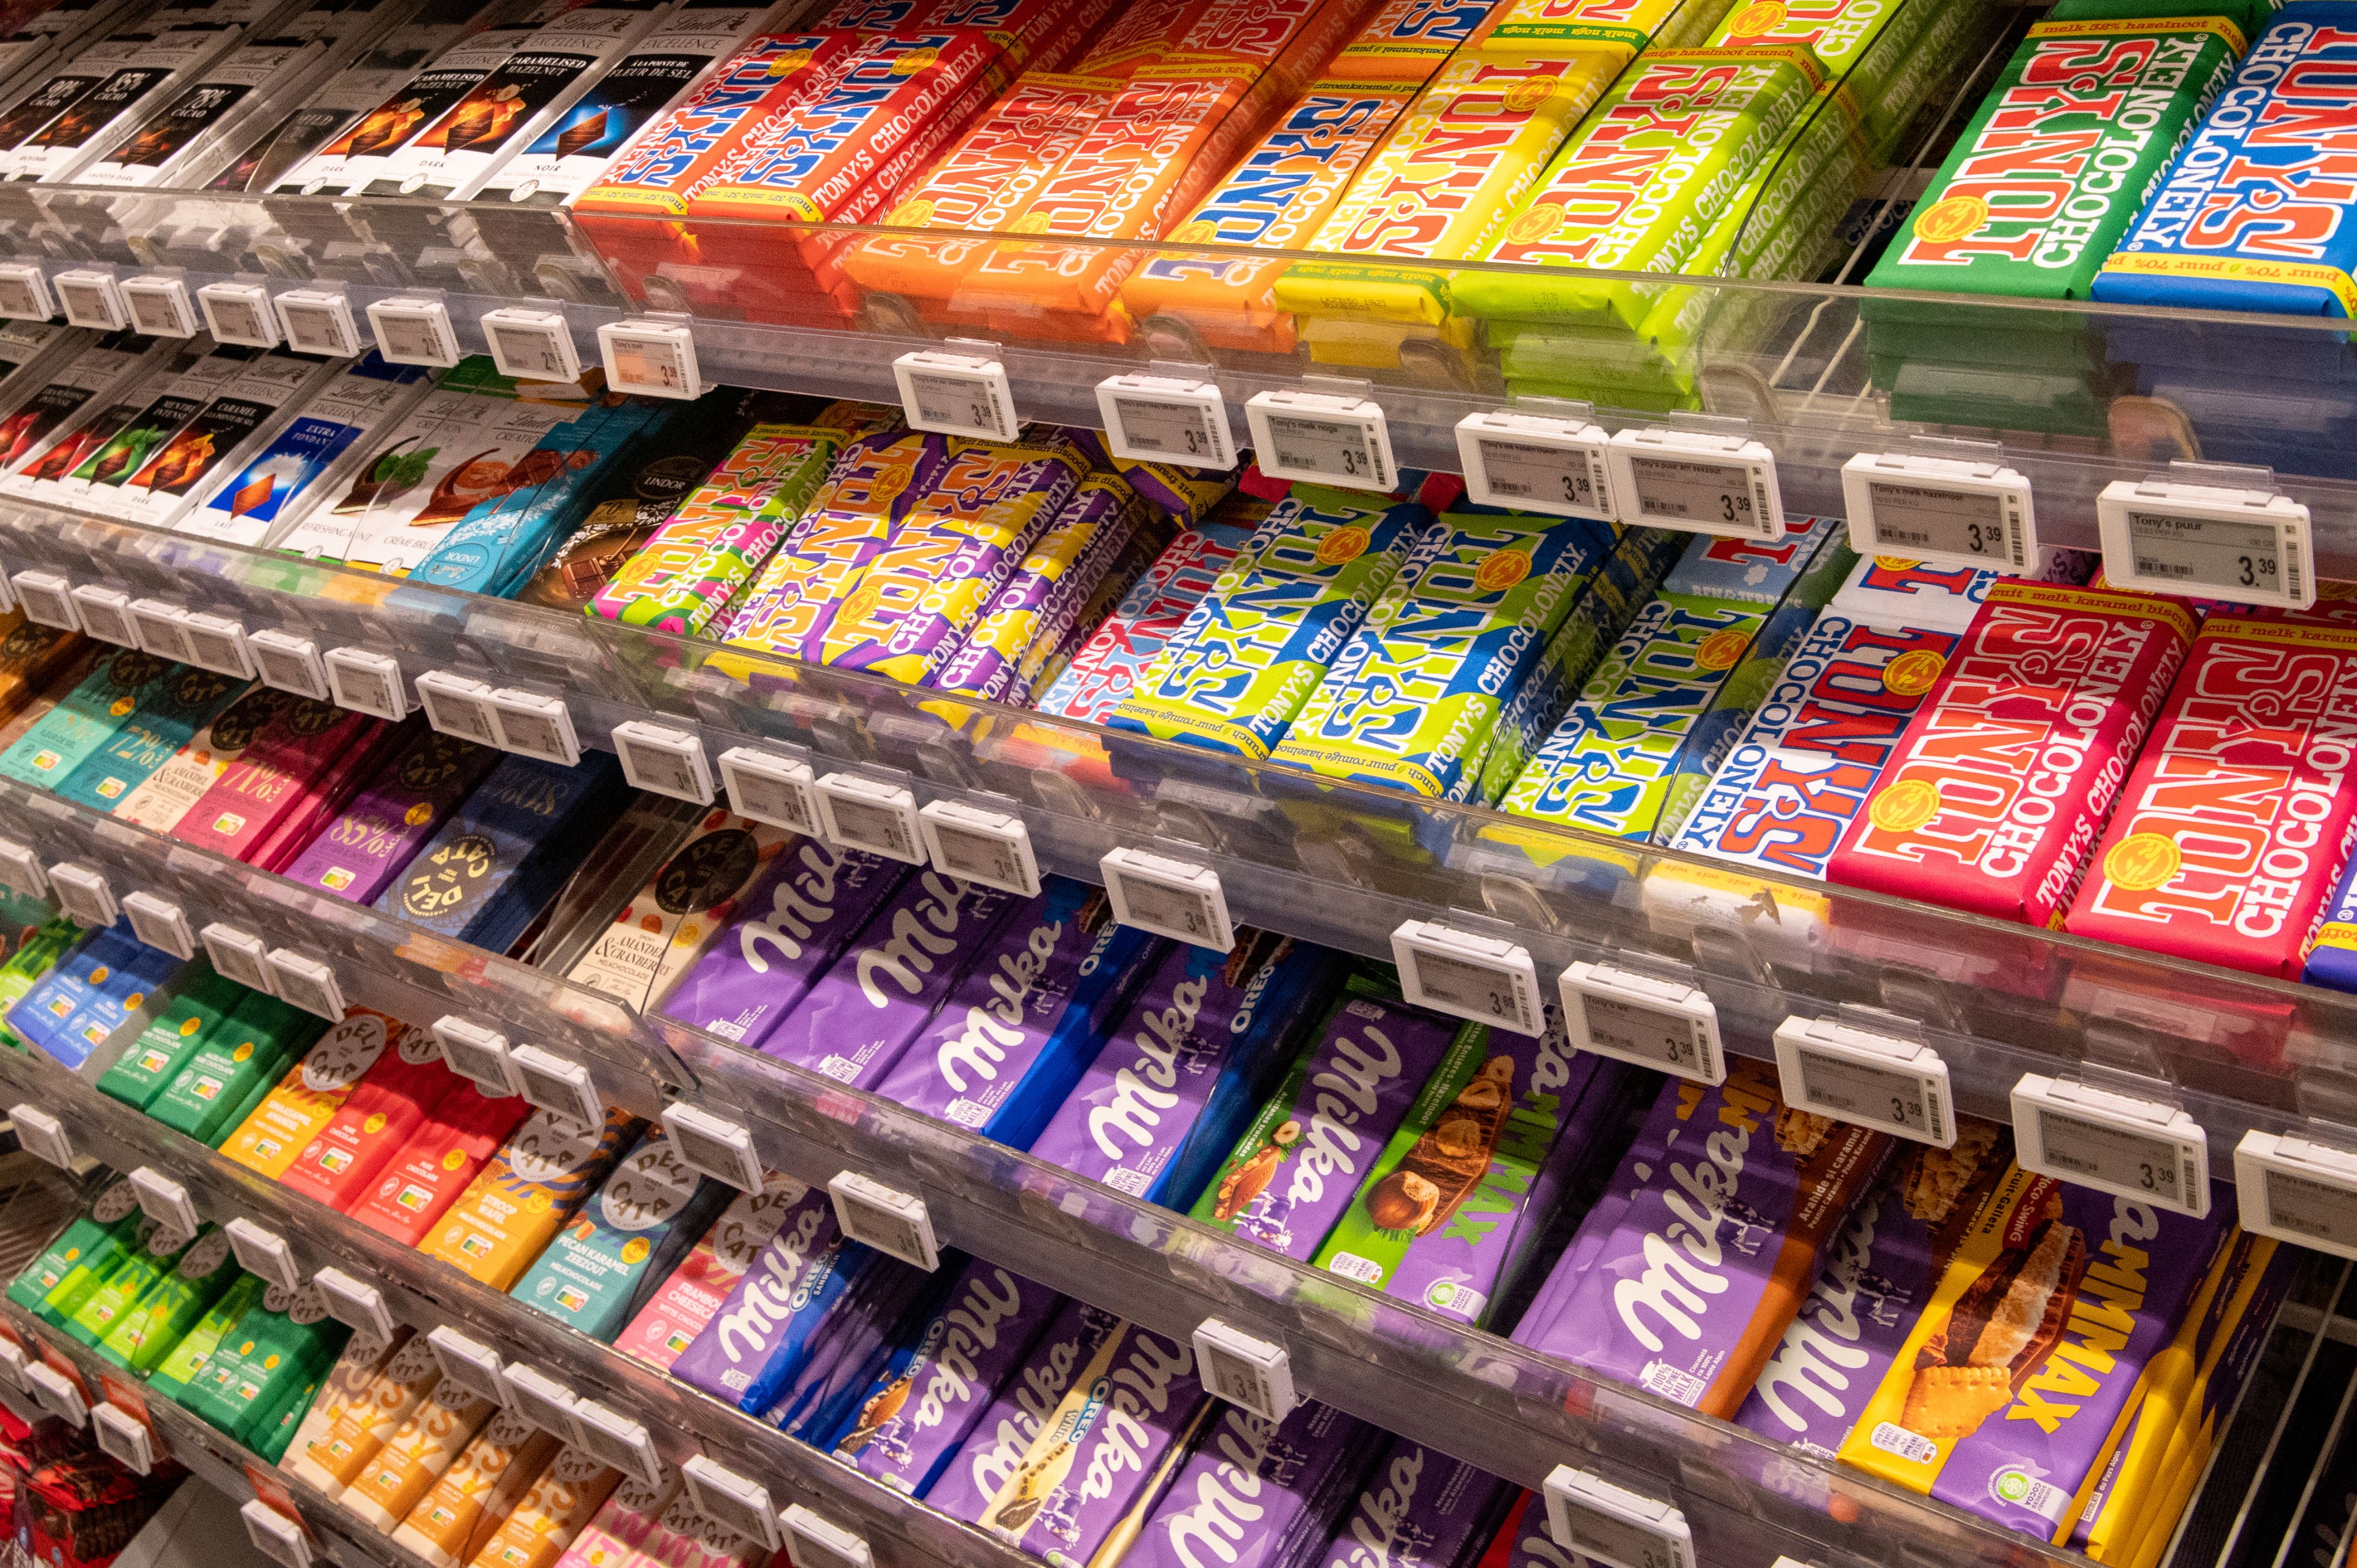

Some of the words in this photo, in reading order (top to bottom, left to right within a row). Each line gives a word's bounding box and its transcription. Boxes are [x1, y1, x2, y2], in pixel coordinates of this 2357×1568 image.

[527, 37, 610, 49] EXCELLENCE
[641, 37, 724, 50] EXCELLENCE
[1502, 26, 1531, 35] noga
[1536, 28, 1565, 36] melk
[1571, 28, 1602, 37] noga
[1606, 28, 1638, 39] melk
[2043, 25, 2084, 33] melk
[2088, 23, 2120, 32] 32%
[2125, 20, 2209, 29] hazelnoot
[505, 66, 567, 77] HAZELNUT
[507, 57, 587, 69] CARAMELISED
[1681, 49, 1744, 57] hazelnoot
[1745, 49, 1795, 58] crunch
[611, 68, 647, 78] FLEUR
[649, 68, 667, 78] DE
[669, 70, 693, 79] SEL
[1313, 83, 1392, 92] citroenkaramel
[604, 36, 762, 187] CHOCOLONELY
[624, 35, 829, 186] TONY'S
[741, 35, 955, 188] TONY'S
[811, 149, 874, 211] TONY'S
[870, 44, 985, 153] CHOCOLONELY
[1898, 38, 2159, 265] TONY'S
[2032, 36, 2199, 268] CHOCOLONELY
[2130, 22, 2313, 249] CHOCOLONELY
[419, 161, 447, 169] DARK
[685, 147, 740, 203] TONY'S
[1310, 59, 1479, 254] CHOCOLONELY
[1343, 59, 1576, 257] TONY'S
[1486, 64, 1741, 265] TONY'S
[1588, 61, 1776, 269] CHOCOLONELY
[980, 81, 1201, 273] TONY'S
[1138, 97, 1380, 280] TONY'S
[1631, 216, 1698, 299] TONY'S
[1696, 77, 1809, 221] CHOCOLONELY
[791, 196, 814, 215] melk
[2134, 258, 2169, 269] 70%
[2175, 261, 2226, 272] puur
[2245, 266, 2282, 277] 70%
[2287, 269, 2341, 283] puur
[307, 425, 335, 436] EXTRA
[1271, 418, 1295, 431] Tony's
[644, 476, 686, 490] LINDOR
[1874, 484, 1900, 496] Tony's
[602, 441, 790, 602] TONY'S
[2134, 515, 2173, 532] Tony's
[2175, 520, 2203, 532] puur
[746, 446, 928, 651] TONY'S
[820, 457, 1021, 647] TONY'S
[888, 459, 1050, 654] CHOCOLONELY
[921, 604, 980, 674] TONY'S
[975, 473, 1081, 606] CHOCOLONELY
[939, 486, 1100, 689] CHOCOLONELY
[2238, 555, 2276, 587] 3.39
[1133, 497, 1302, 692] CHOCOLONELY
[1156, 507, 1386, 716] TONY'S
[1043, 532, 1203, 714] CHOCOLONELY
[1248, 662, 1314, 737] TONY'S
[1307, 523, 1419, 663] CHOCOLONELY
[1295, 522, 1453, 737] CHOCOLONELY
[2032, 592, 2072, 604] melk
[2074, 594, 2143, 612] karamel
[2147, 603, 2194, 639] biscuit
[2251, 625, 2294, 638] melk
[1319, 528, 1547, 753] TONY'S
[1426, 694, 1487, 775] TONY'S
[1478, 543, 1582, 694] CHOCOLONELY
[1159, 715, 1193, 728] romige
[1509, 600, 1672, 811] CHOCOLONELY
[1534, 606, 1768, 831] TONY'S
[1193, 723, 1222, 734] puur
[1680, 617, 1852, 849] CHOCOLONELY
[1851, 607, 2108, 866] TONY'S
[1327, 753, 1366, 768] romige
[1365, 762, 1397, 773] puur
[1716, 626, 1958, 874] TONY'S
[1980, 621, 2150, 878] CHOCOLONELY
[2035, 815, 2093, 908] TONY'S
[2087, 636, 2186, 817] CHOCOLONELY
[2091, 643, 2341, 926] TONY'S
[430, 845, 489, 878] CATA
[411, 874, 463, 911] DELI
[595, 937, 615, 957] &
[610, 947, 673, 976] CRANBERRY
[617, 936, 663, 958] AMANDEL
[597, 959, 650, 981] MELKCHOCOLADE
[937, 920, 1062, 1092] Milka
[1230, 964, 1276, 1033] OREO
[837, 1064, 856, 1079] MILK
[1089, 975, 1207, 1160] Milka
[966, 1106, 984, 1124] MILK
[1289, 1026, 1402, 1211] Milka
[520, 1134, 574, 1173] CATA
[637, 1149, 692, 1185] DELI
[1124, 1174, 1144, 1193] MILK
[1799, 1180, 1830, 1222] Arahide
[1833, 1127, 1863, 1169] caramel
[478, 1203, 506, 1226] WAFEL
[480, 1193, 518, 1216] STROOP
[611, 1180, 672, 1220] CATA
[1807, 1204, 1828, 1230] Peanut
[556, 1236, 589, 1255] PECAN
[587, 1247, 630, 1276] KARAMEL
[1614, 1125, 1749, 1353] Milka
[564, 1251, 608, 1277] ZEEZOUT
[789, 1252, 830, 1311] OREO
[719, 1204, 827, 1364] Milka
[1451, 1288, 1465, 1308] COCOA
[905, 1317, 946, 1378] OREO
[914, 1268, 1020, 1432] Milka
[1702, 1355, 1713, 1370] 100%
[1650, 1365, 1672, 1388] 100%
[1661, 1369, 1682, 1394] ALPINE
[1670, 1374, 1695, 1401] MILK
[1703, 1364, 1717, 1380] Lapte
[1069, 1376, 1111, 1443] OREO
[1685, 1380, 1704, 1405] CHOCOLATE
[1081, 1334, 1193, 1505] Milka
[2024, 1482, 2041, 1506] COCOA
[2031, 1486, 2047, 1509] SOURCED
[2083, 1493, 2101, 1520] CHOCOLATE
[2103, 1468, 2114, 1483] Pays
[2111, 1451, 2121, 1470] Alpin
